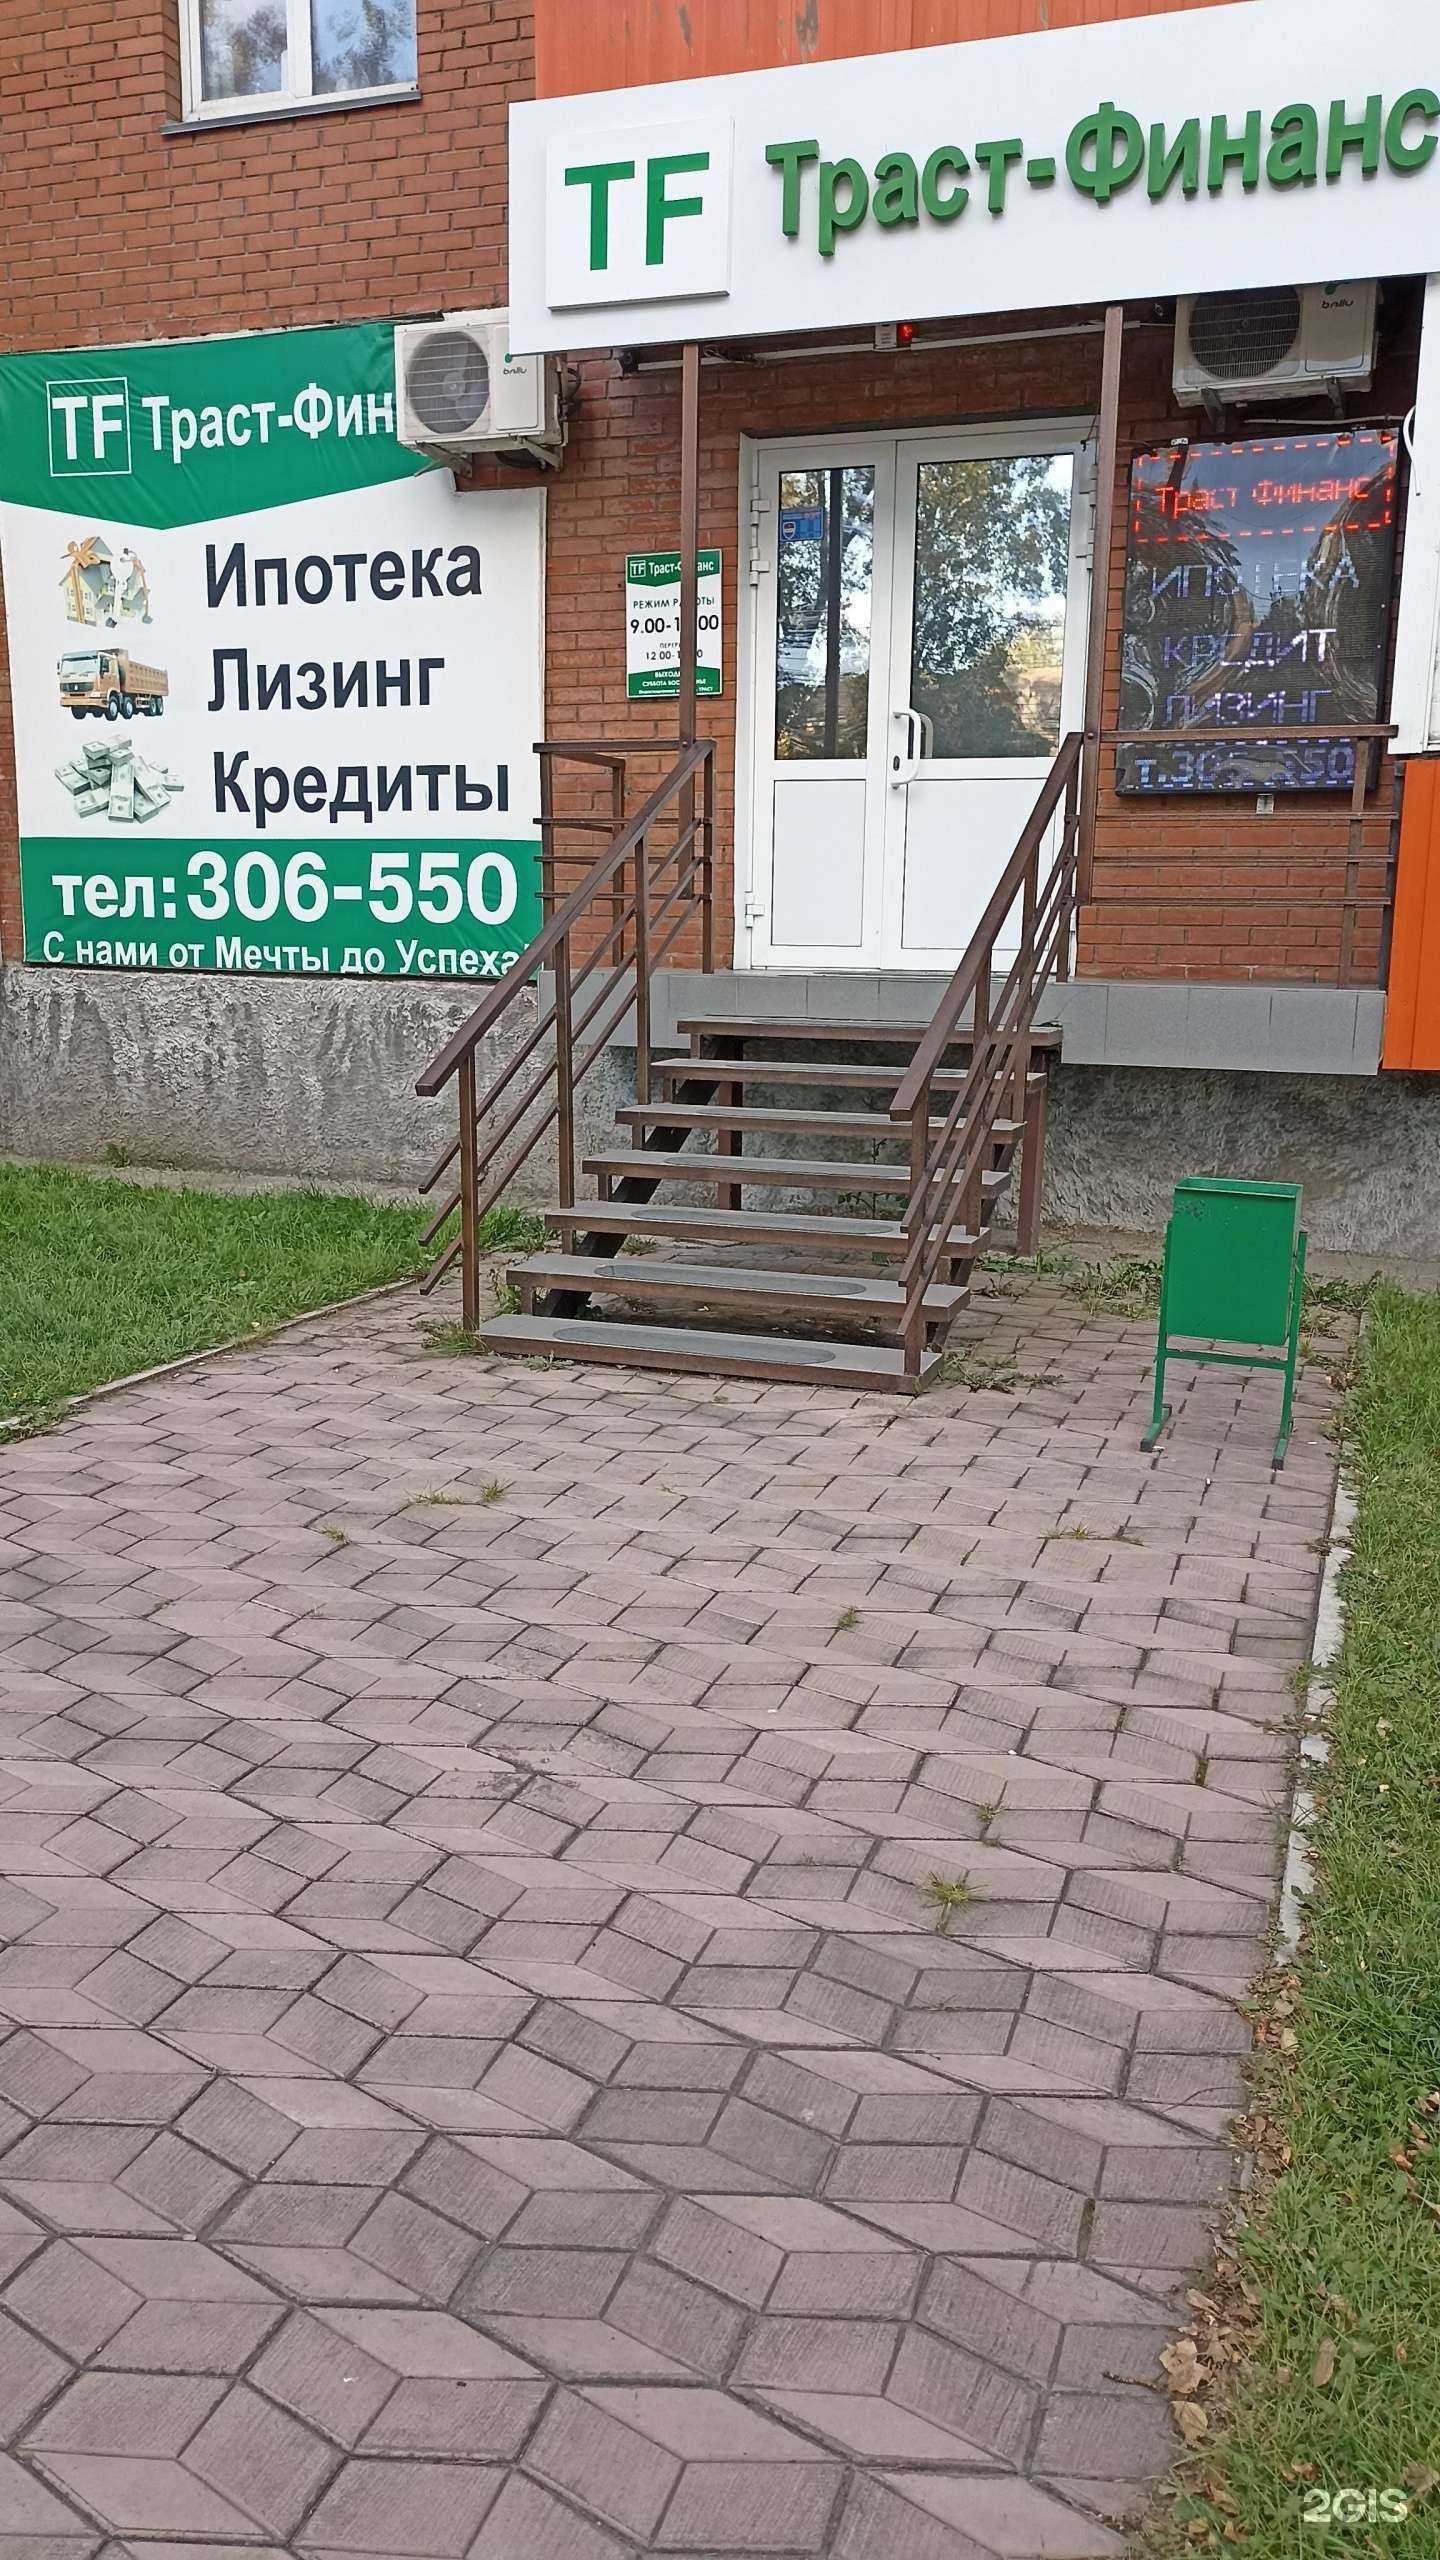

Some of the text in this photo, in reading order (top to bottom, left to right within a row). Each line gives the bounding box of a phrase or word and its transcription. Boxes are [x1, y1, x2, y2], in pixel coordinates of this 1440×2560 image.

[764, 88, 1440, 258] Траст-Финанс
[564, 152, 711, 272] TF
[52, 394, 125, 461] TF
[142, 383, 394, 464] Траст-Фин
[1155, 477, 1371, 519] Траст Финанс
[205, 542, 483, 608] Ипотека
[649, 561, 714, 577] Траст-анс
[630, 615, 719, 634] 9.00-100
[633, 596, 715, 609] РЕЖИМ РОТЫ
[208, 648, 445, 712] Лизинг
[213, 750, 510, 828] Кредиты
[43, 930, 530, 976] С нами от Мечты до Успеха
